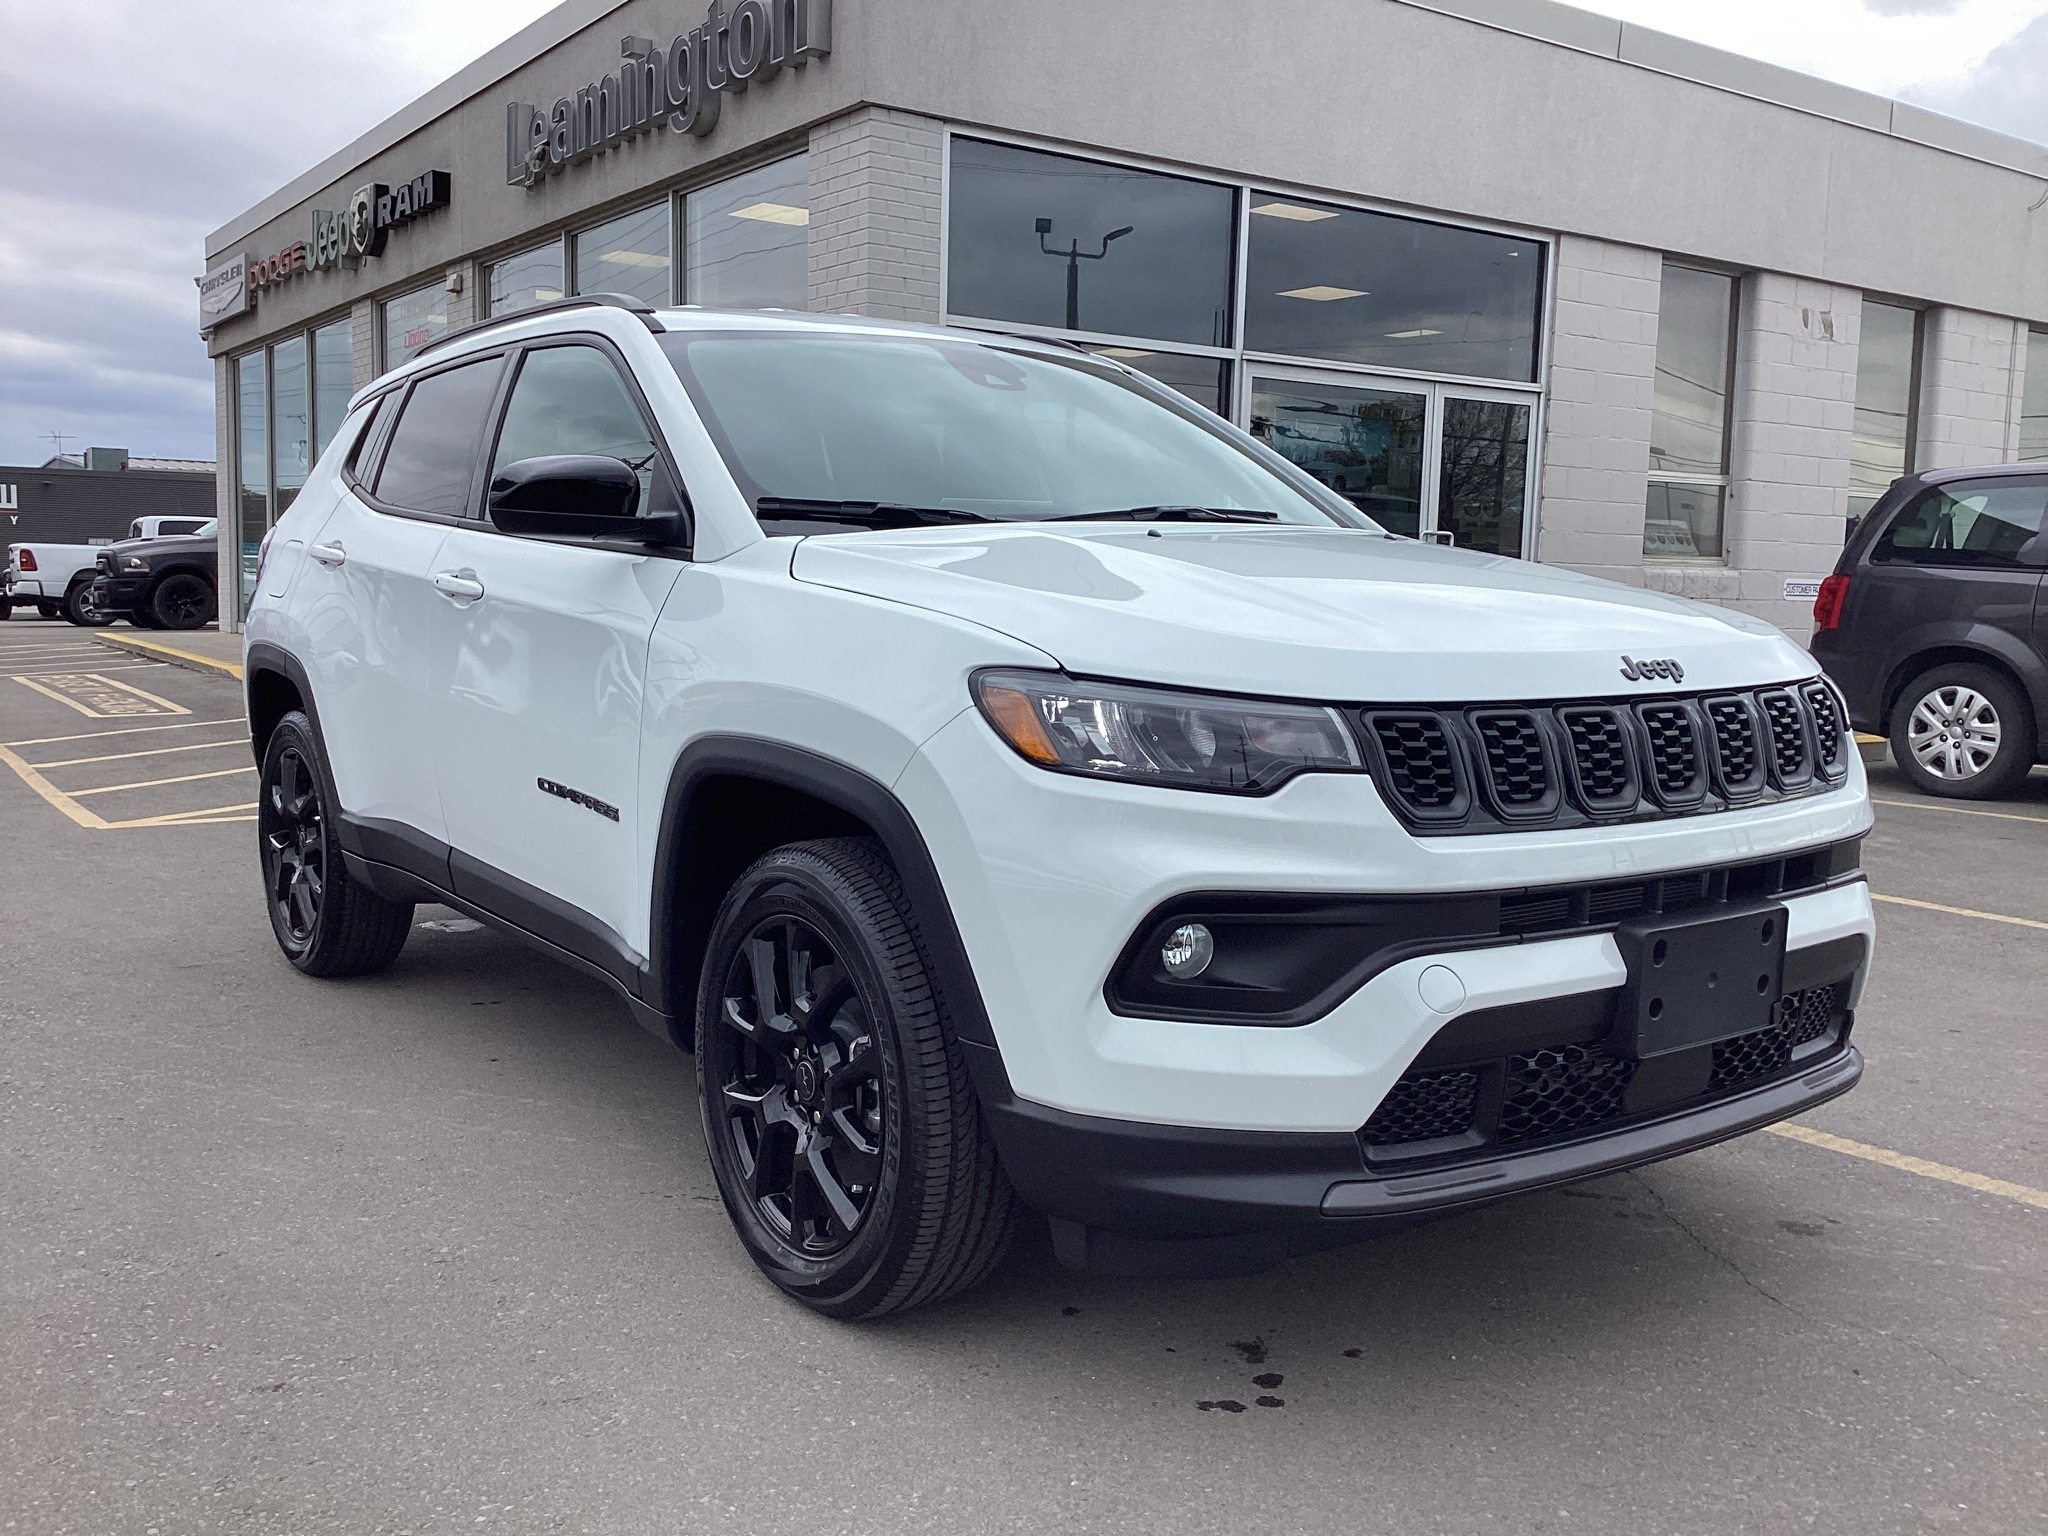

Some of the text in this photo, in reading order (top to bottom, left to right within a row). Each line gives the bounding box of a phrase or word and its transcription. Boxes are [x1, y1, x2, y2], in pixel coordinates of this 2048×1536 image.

[506, 0, 818, 186] Leamington
[377, 169, 437, 229] RAM
[249, 240, 303, 290] DODGE
[305, 209, 351, 272] Jeep
[200, 263, 243, 296] CHRYSLER
[1620, 655, 1684, 684] Jeep
